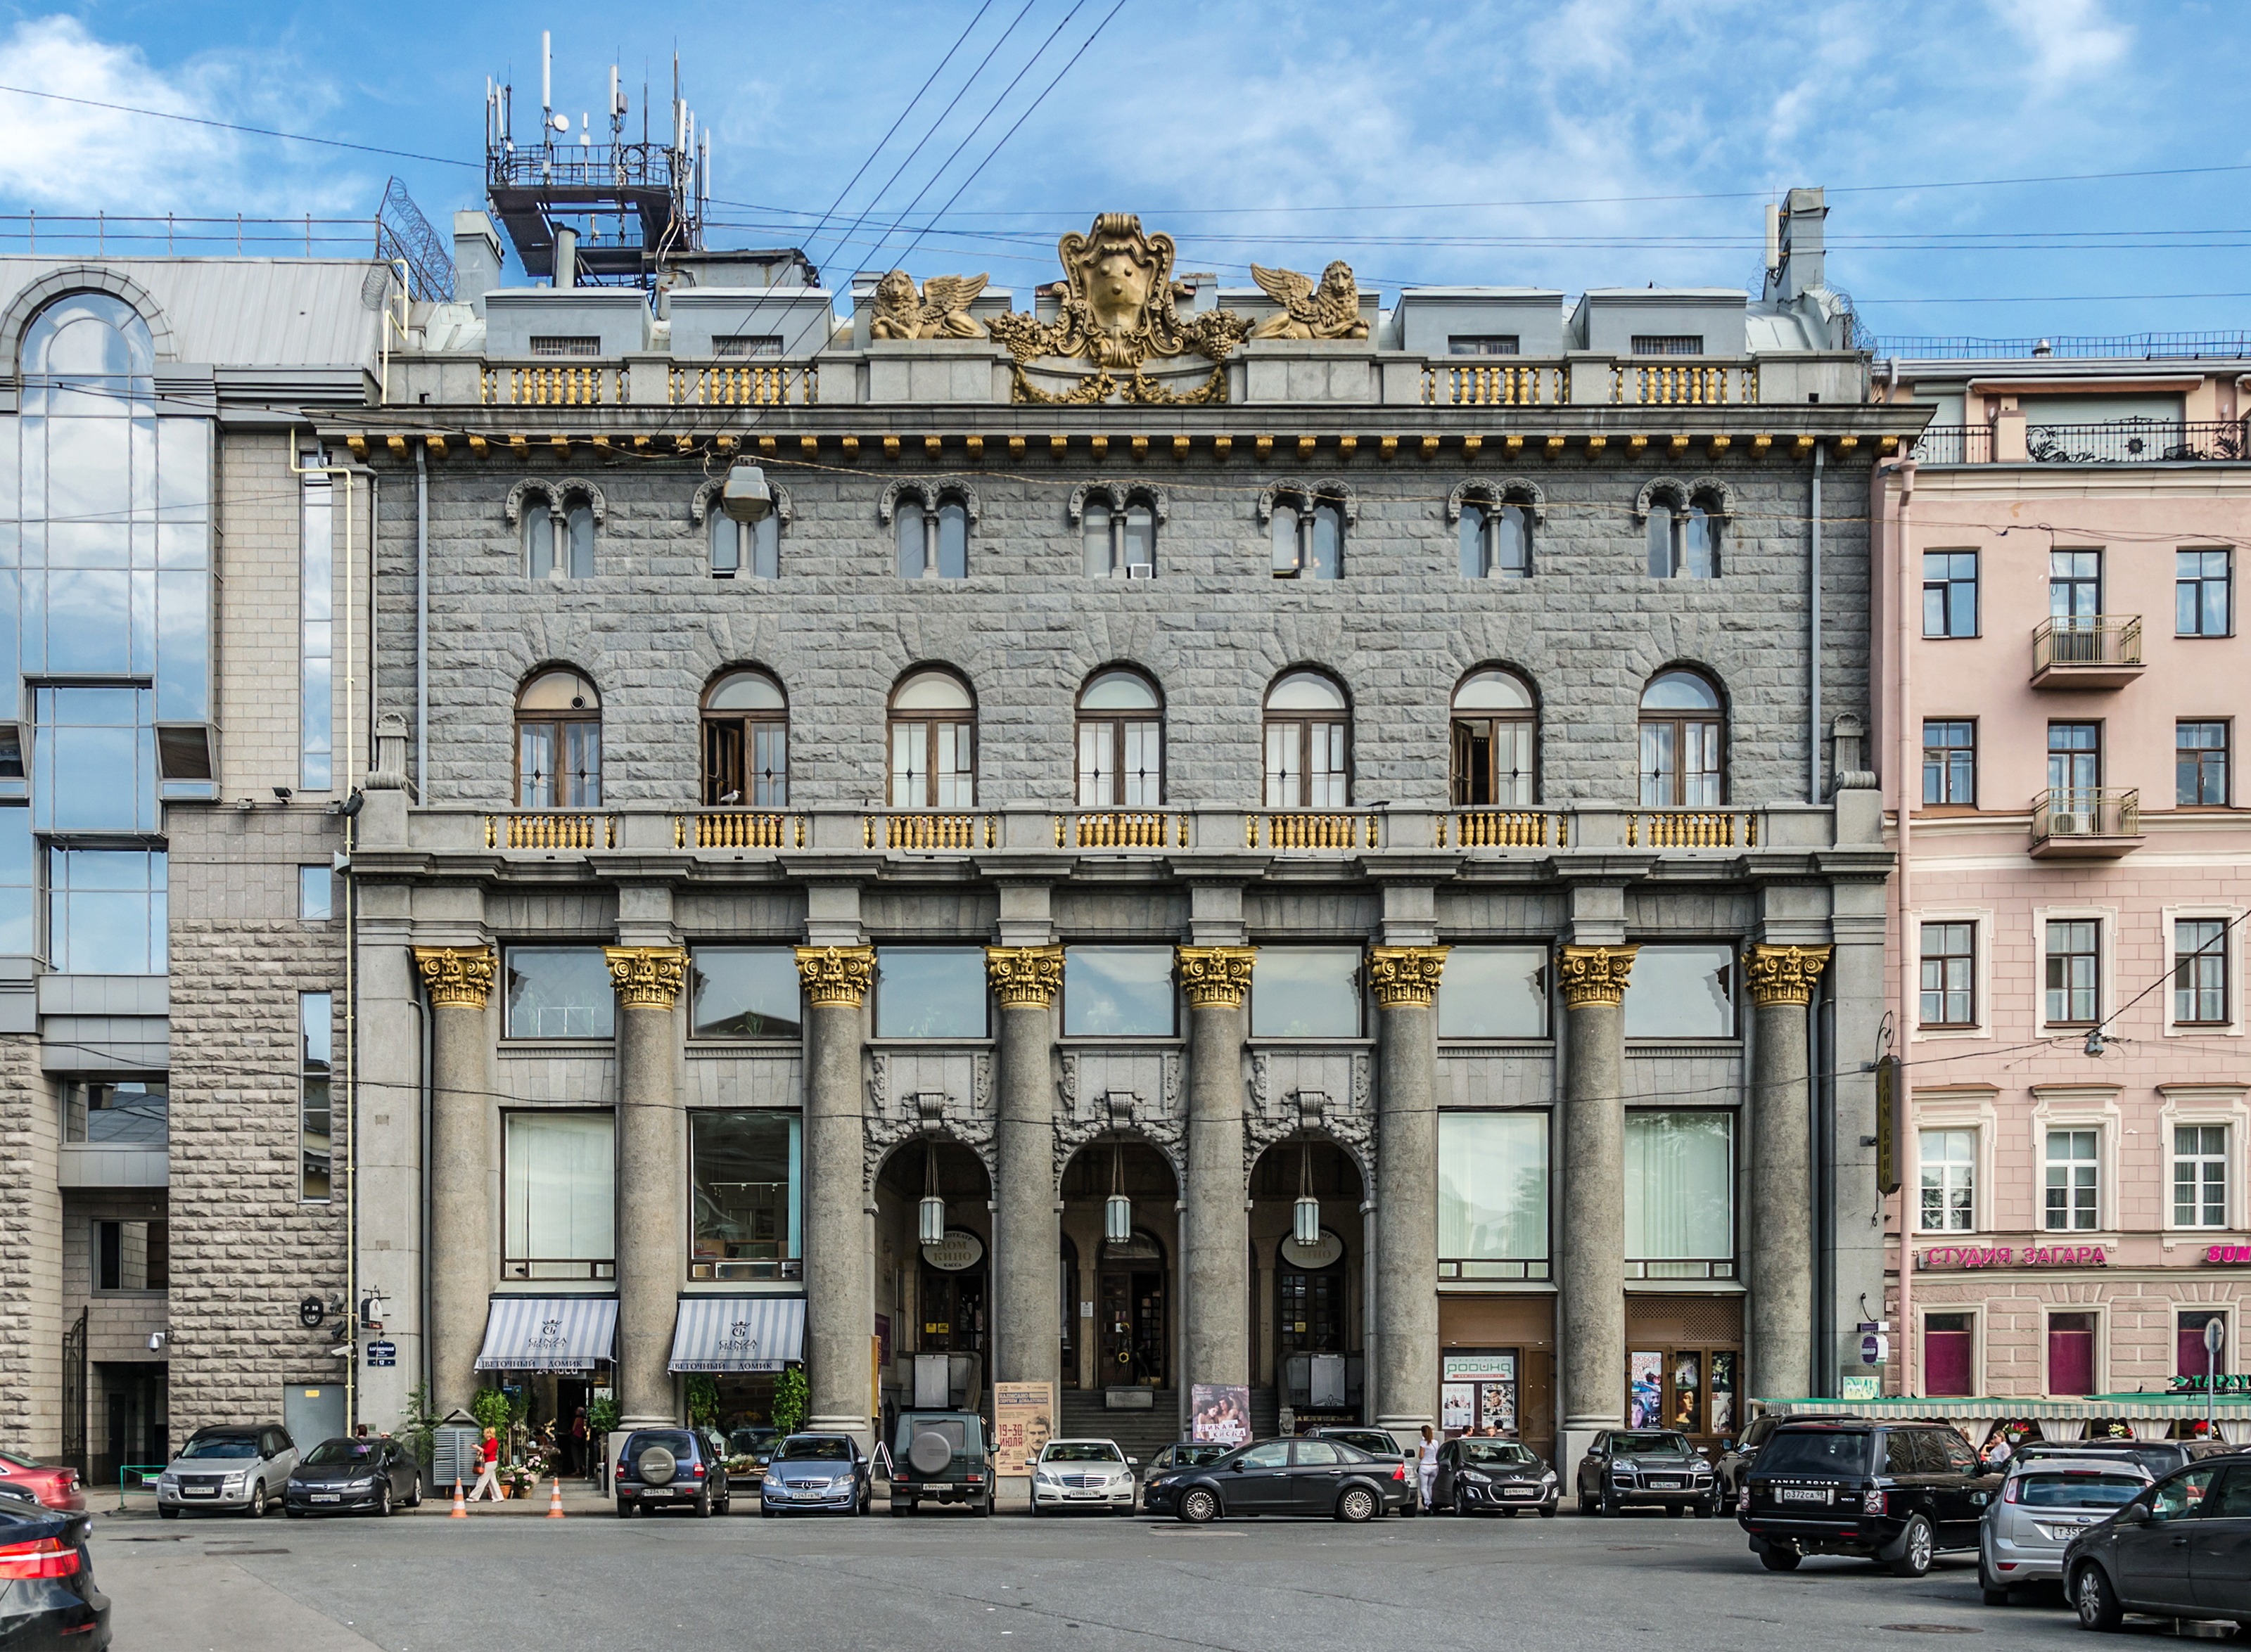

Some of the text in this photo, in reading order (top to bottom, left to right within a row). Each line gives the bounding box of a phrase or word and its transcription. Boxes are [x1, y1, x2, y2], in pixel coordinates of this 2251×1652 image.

[943, 1232, 972, 1241] НОТЕАТР
[938, 1241, 968, 1251] ДОМ
[933, 1252, 972, 1261] КИНО
[1928, 1247, 2106, 1268] СТУДИЯ ЗАГАРА
[478, 1359, 536, 1368] ЦВЕТОЧНЫЙ
[738, 1362, 772, 1371] ДОМИК
[1201, 1423, 1233, 1432] ДИКАЯ
[1000, 1437, 1023, 1447] ИЮЛЯ
